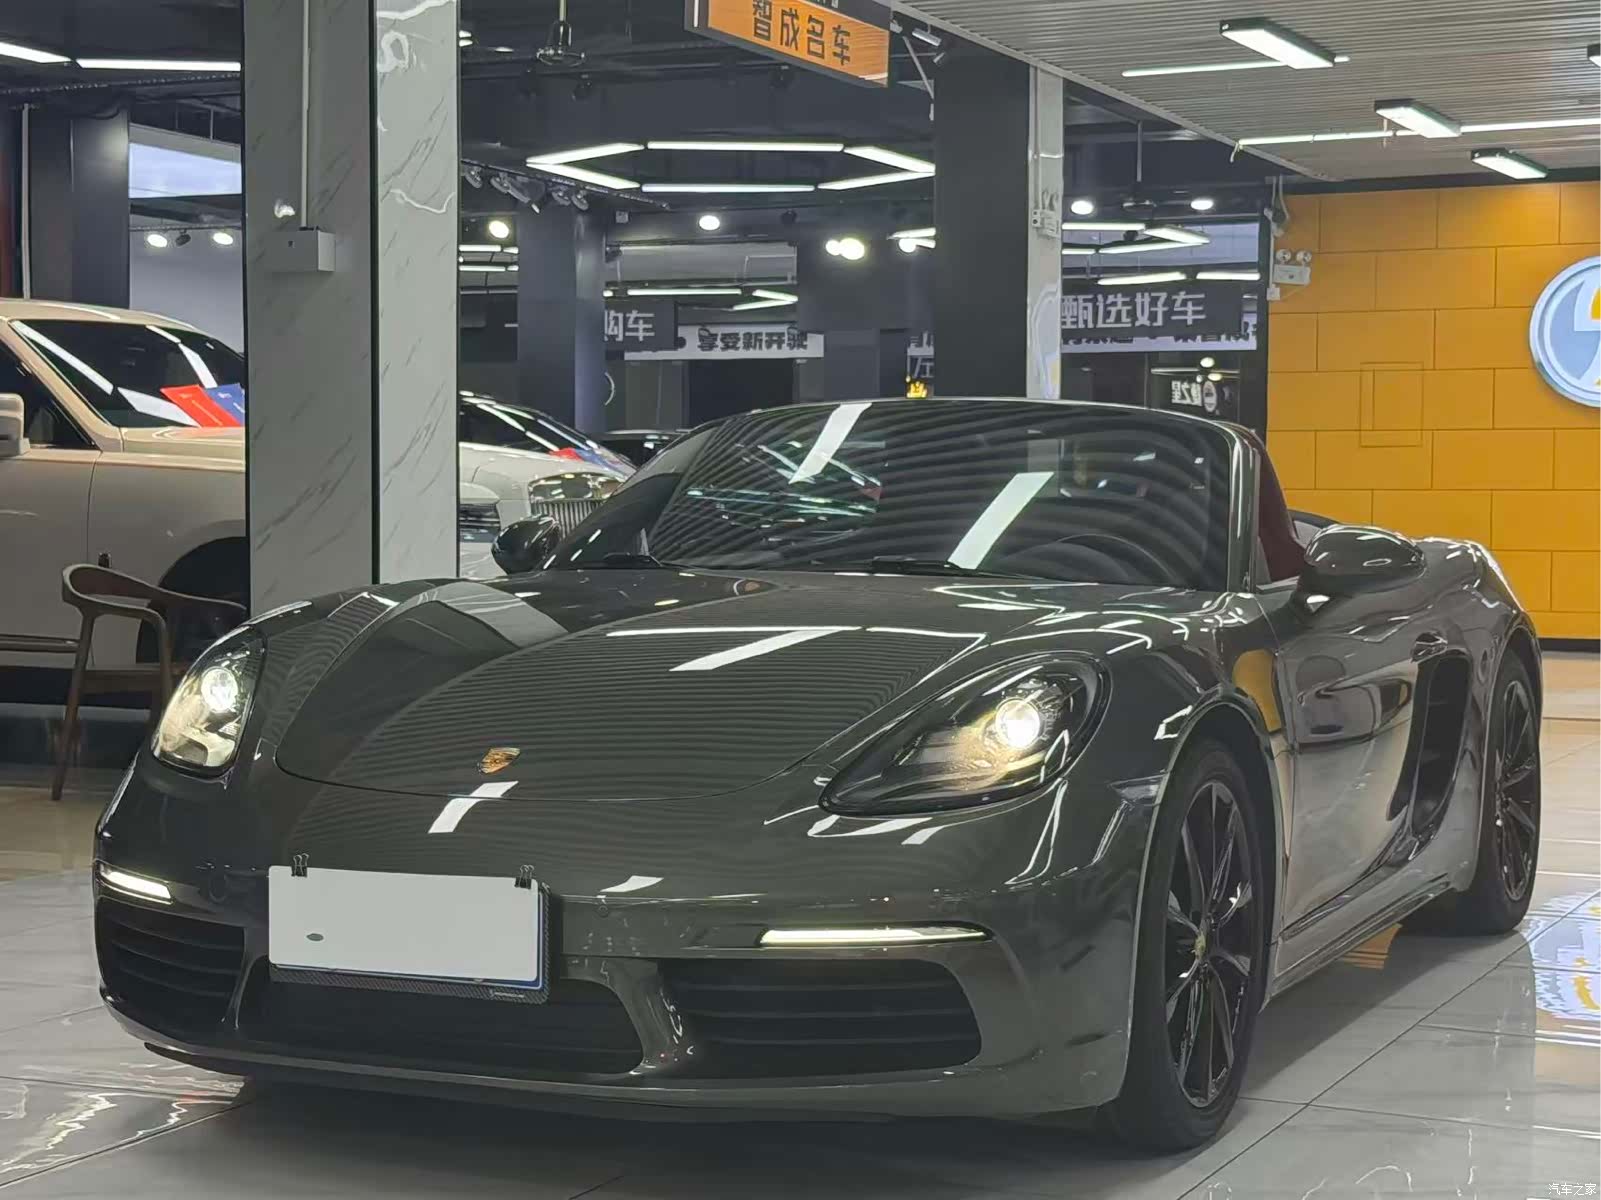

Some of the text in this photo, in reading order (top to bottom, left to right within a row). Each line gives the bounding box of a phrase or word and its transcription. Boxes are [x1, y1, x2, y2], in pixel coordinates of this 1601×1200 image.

[752, 0, 851, 66] 智成名车
[604, 309, 656, 342] 购车
[1061, 290, 1207, 329] 甄选好车
